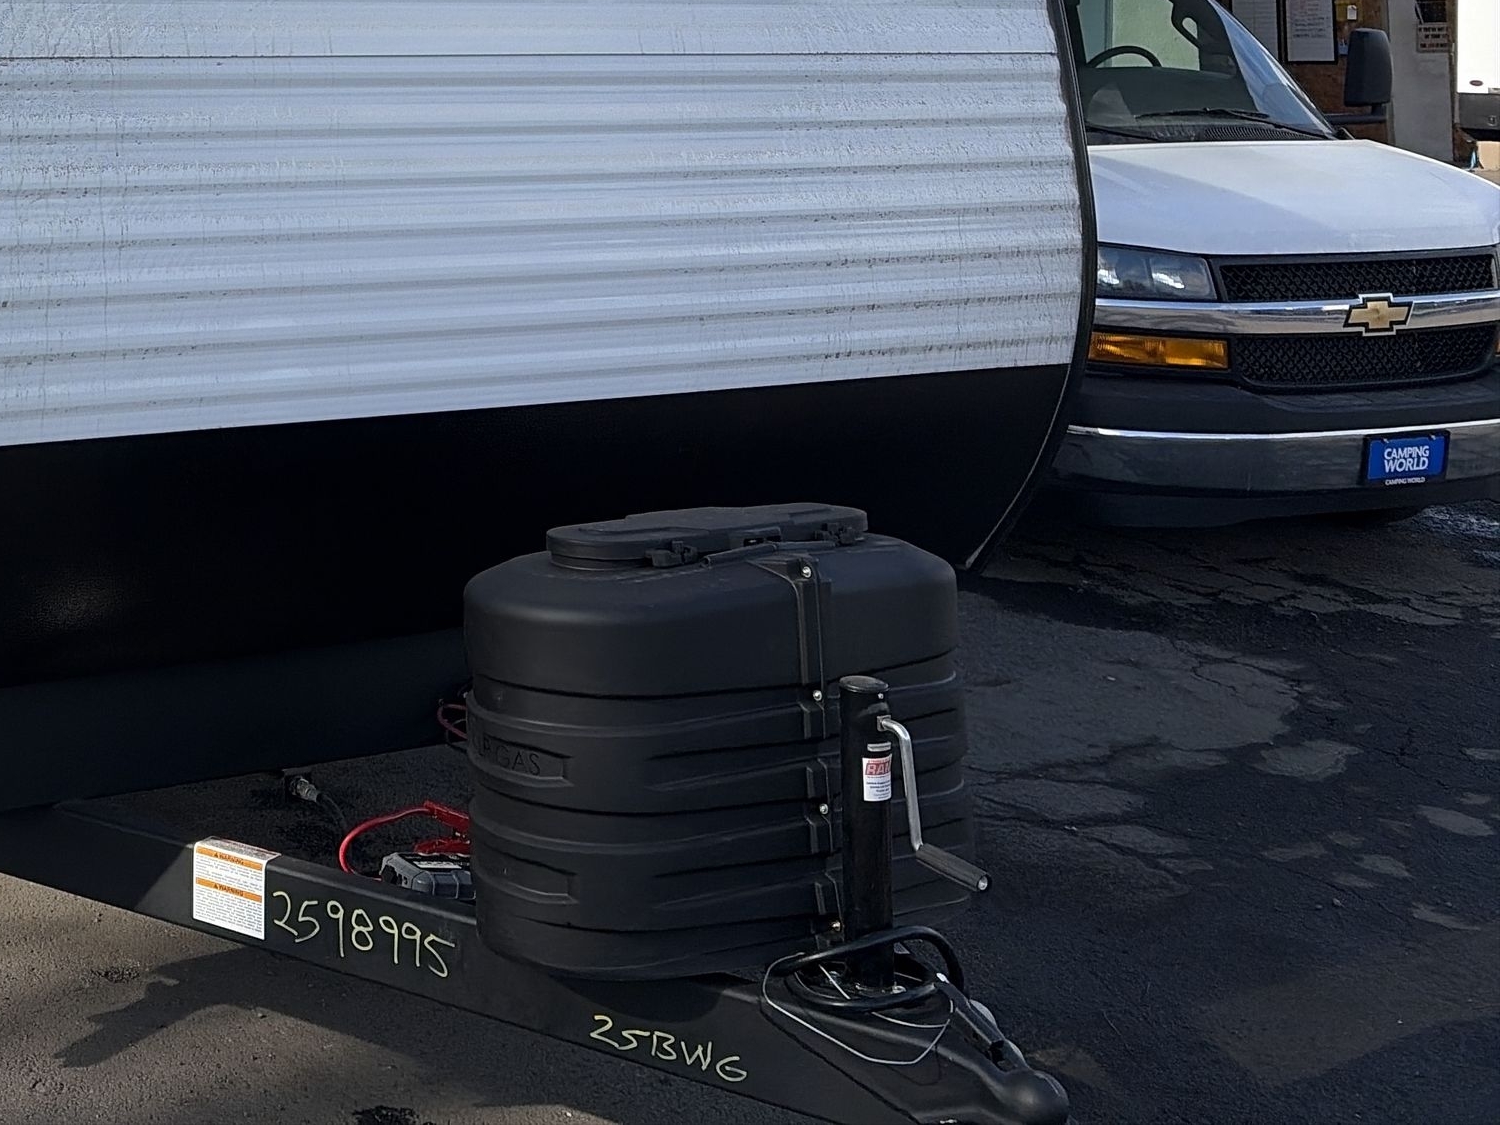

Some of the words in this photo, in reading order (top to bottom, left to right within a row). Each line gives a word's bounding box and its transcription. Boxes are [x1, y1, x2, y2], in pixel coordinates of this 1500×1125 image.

[1383, 445, 1430, 460] CAMPING
[1384, 457, 1429, 473] WORLD
[1385, 477, 1407, 486] CAMPING
[1407, 476, 1426, 484] WORLD
[495, 745, 541, 776] GAS
[272, 891, 456, 978] 2598995
